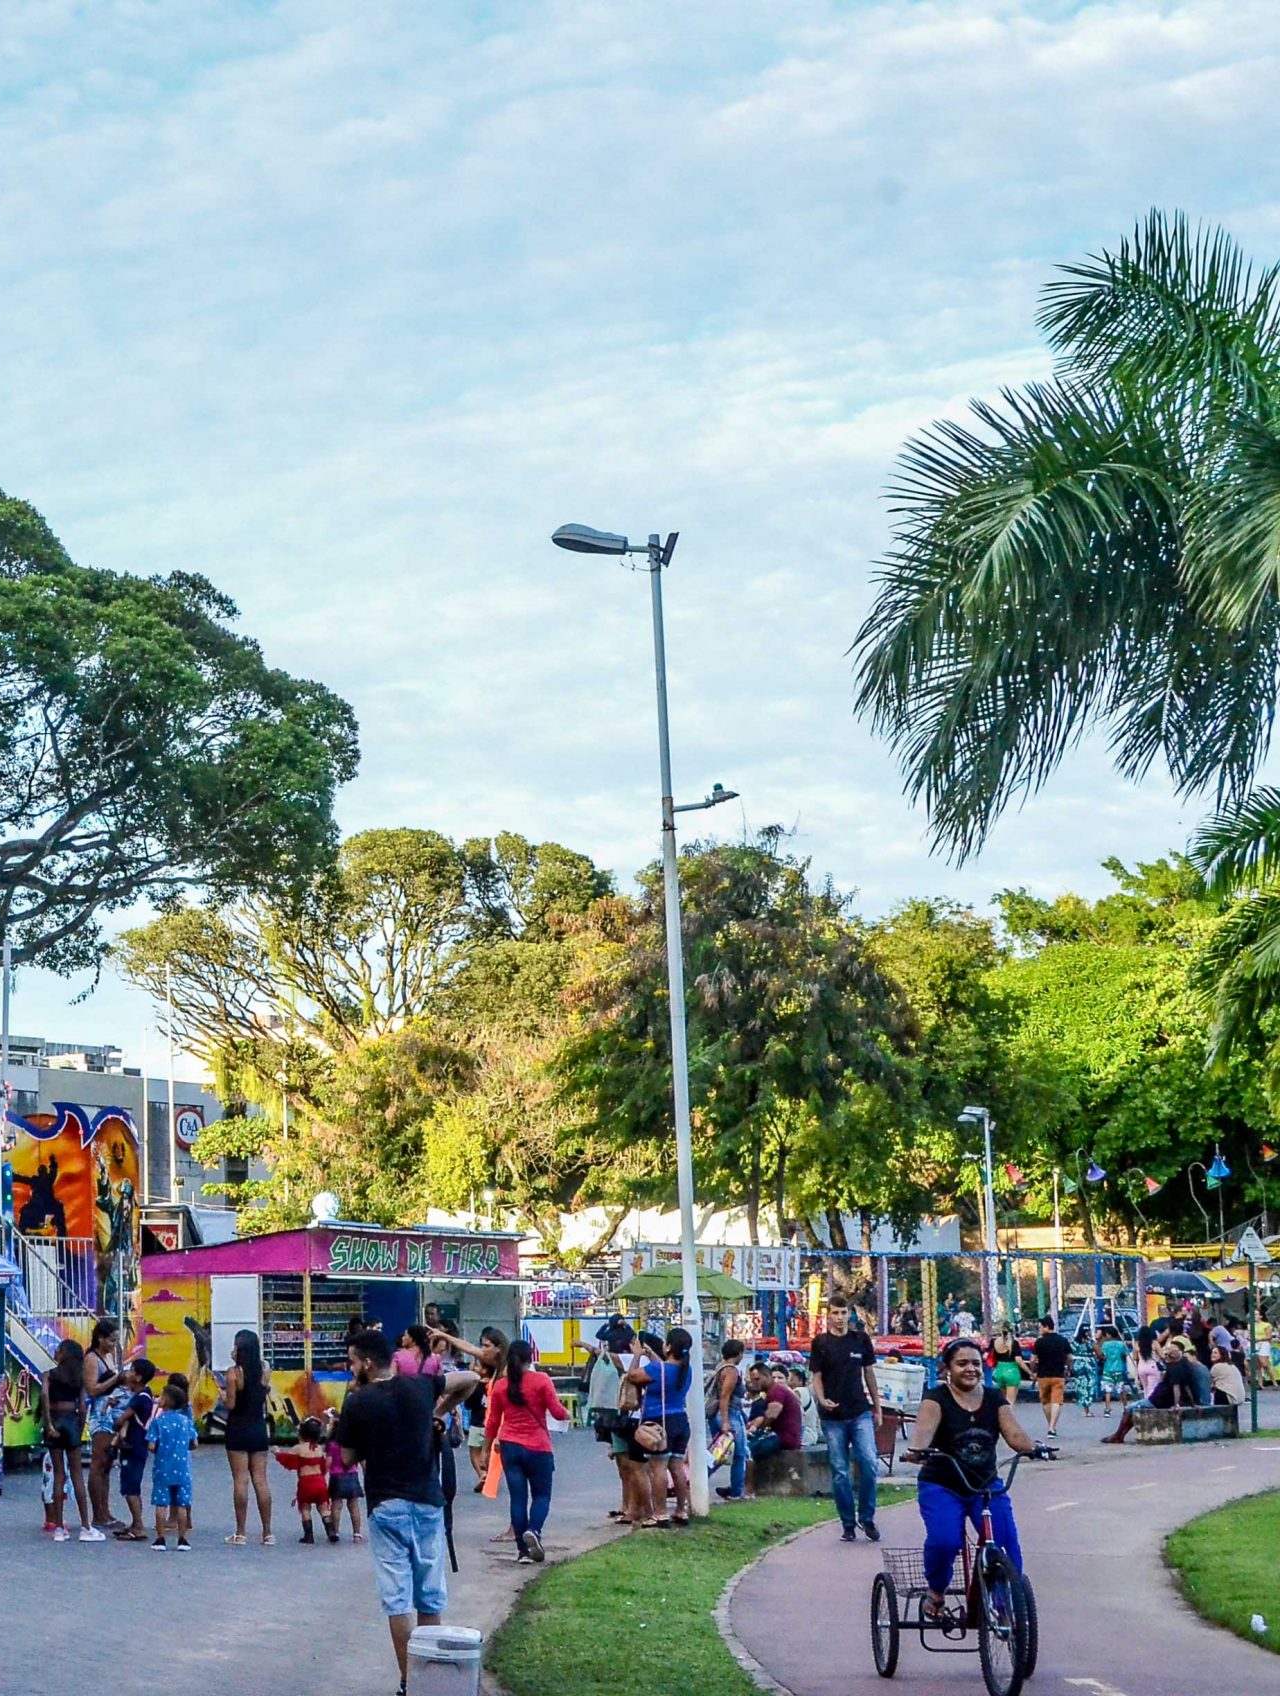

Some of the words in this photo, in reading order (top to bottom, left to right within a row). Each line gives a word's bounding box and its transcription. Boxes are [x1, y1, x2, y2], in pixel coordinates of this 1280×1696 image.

[179, 1117, 200, 1137] C&A
[327, 1235, 399, 1272] SHOW
[406, 1239, 433, 1273] DE
[442, 1241, 500, 1275] TIRO
